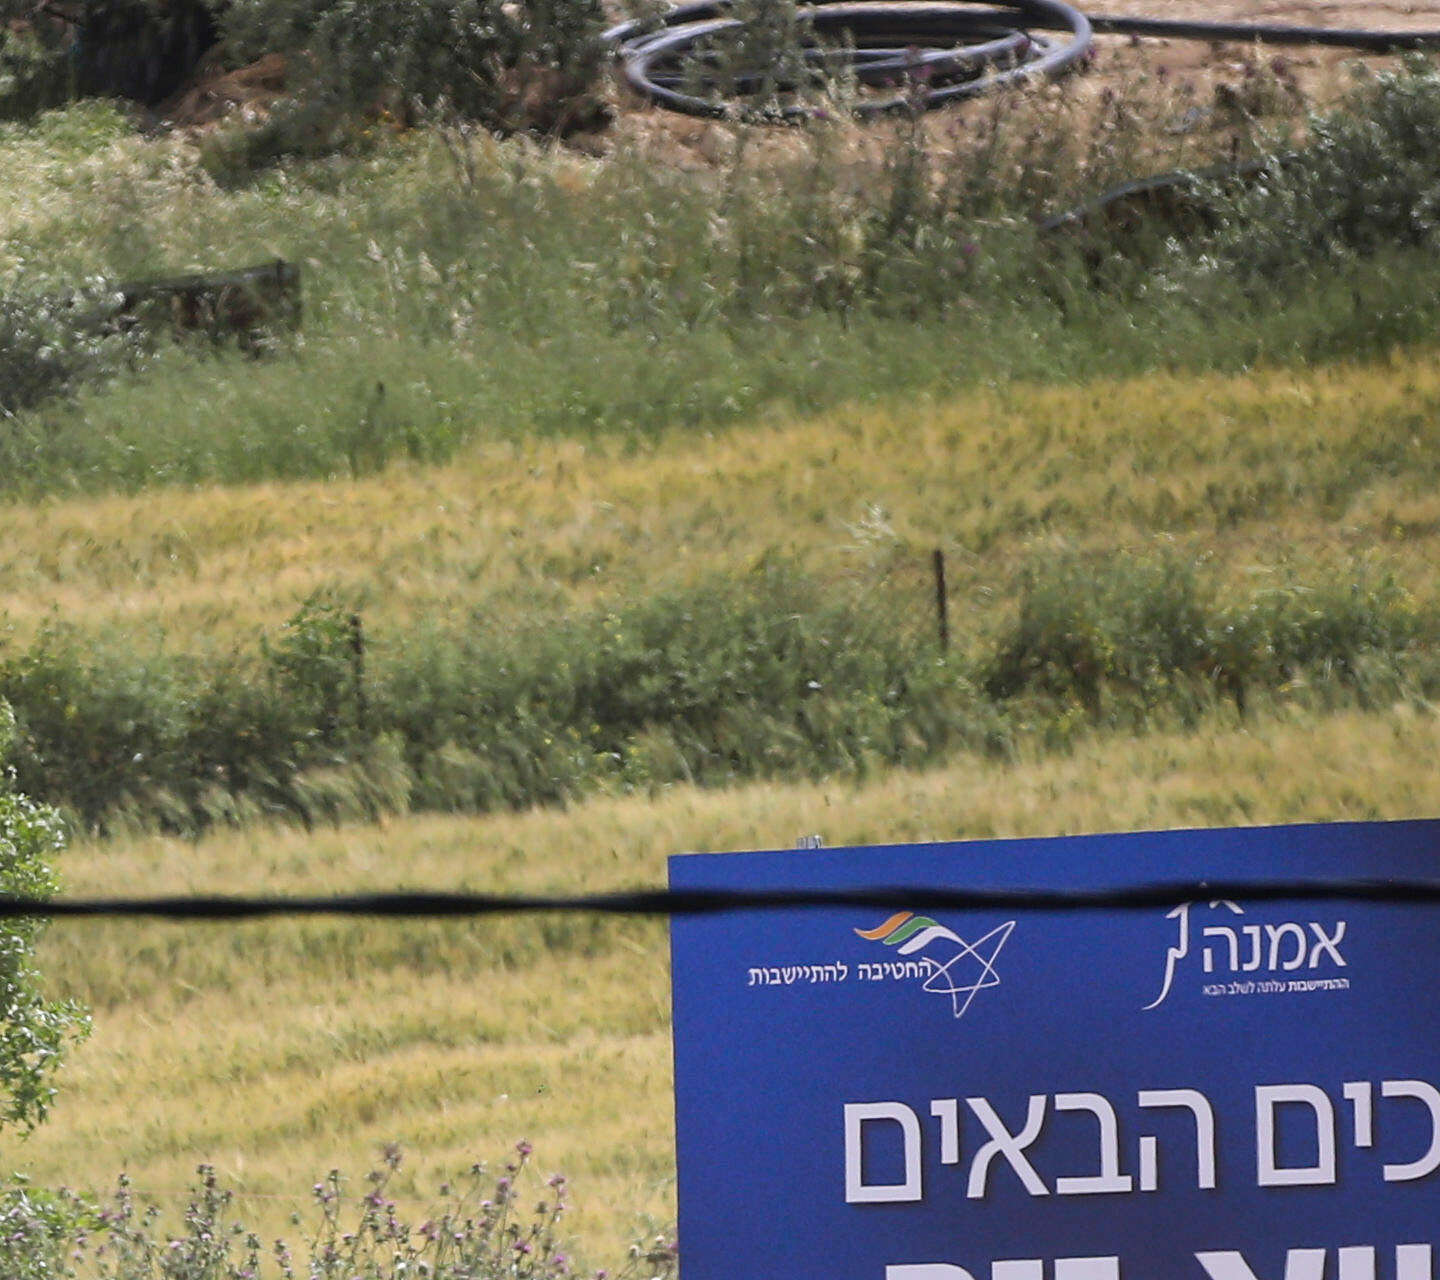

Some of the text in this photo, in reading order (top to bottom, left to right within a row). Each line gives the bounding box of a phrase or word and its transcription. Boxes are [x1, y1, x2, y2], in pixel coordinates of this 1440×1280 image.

[1203, 920, 1348, 973] אמנה
[747, 960, 932, 987] החטיבה להתיישבות
[844, 1088, 1215, 1203] הבאים
